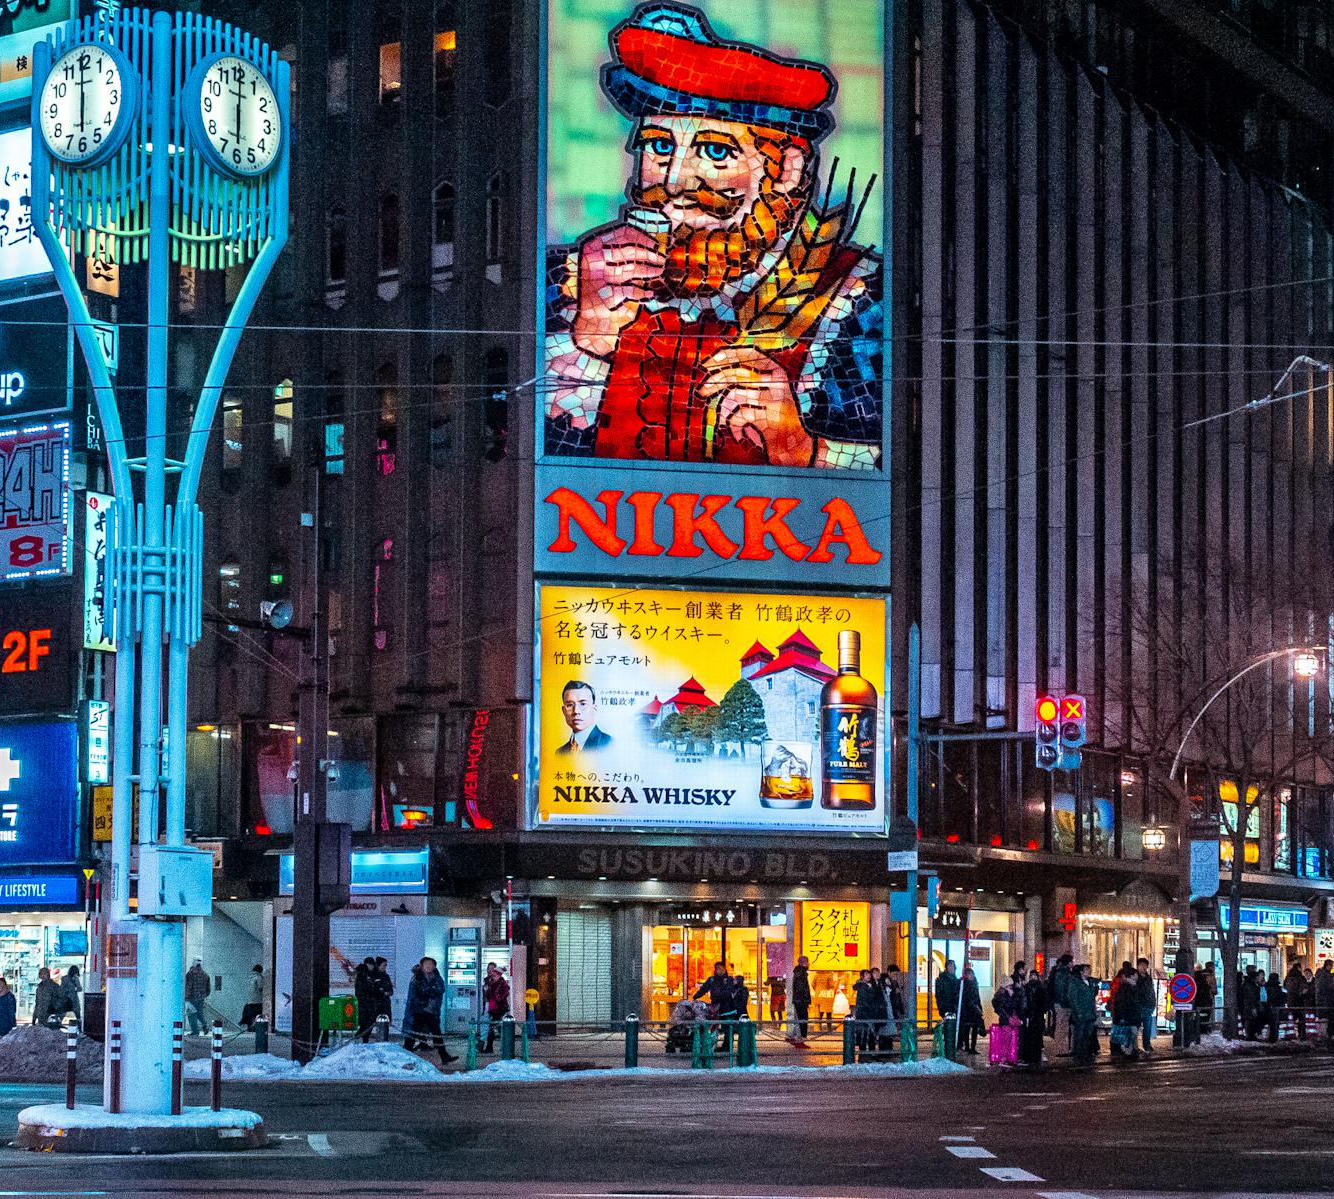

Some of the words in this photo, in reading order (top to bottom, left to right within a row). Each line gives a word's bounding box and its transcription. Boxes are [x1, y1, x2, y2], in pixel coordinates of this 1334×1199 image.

[77, 54, 91, 71] 12
[96, 58, 104, 74] 1
[63, 65, 76, 81] 11
[105, 69, 115, 85] 2
[52, 83, 67, 99] 10
[109, 90, 119, 105] 3
[49, 103, 58, 119] 9
[103, 111, 113, 126] 4
[53, 122, 63, 138] 8
[93, 128, 102, 144] 5
[65, 134, 75, 150] 7
[78, 136, 87, 152] 6
[545, 487, 883, 566] NIKKA
[9, 534, 60, 570] 8F
[553, 598, 744, 621] ニッカウヰスキー創業者
[755, 603, 852, 623] 竹鶴政孝の
[553, 621, 731, 645] 名を冠するウイスキー。
[2, 630, 52, 674] 2F
[553, 651, 652, 667] 竹鶴ピュアモルト
[599, 696, 636, 707] 竹鶴政孝
[838, 713, 860, 762] 竹鶴
[553, 771, 646, 785] 本物への、こだわり。
[553, 785, 639, 805] NIKKA
[643, 787, 737, 807] WHISKY
[577, 847, 751, 877] SUSUKINO
[763, 852, 838, 880] BLD.
[5, 883, 47, 897] LIFESTYLE
[842, 908, 860, 943] 札幌
[808, 907, 824, 965] スクエア
[827, 907, 841, 963] タイムズ
